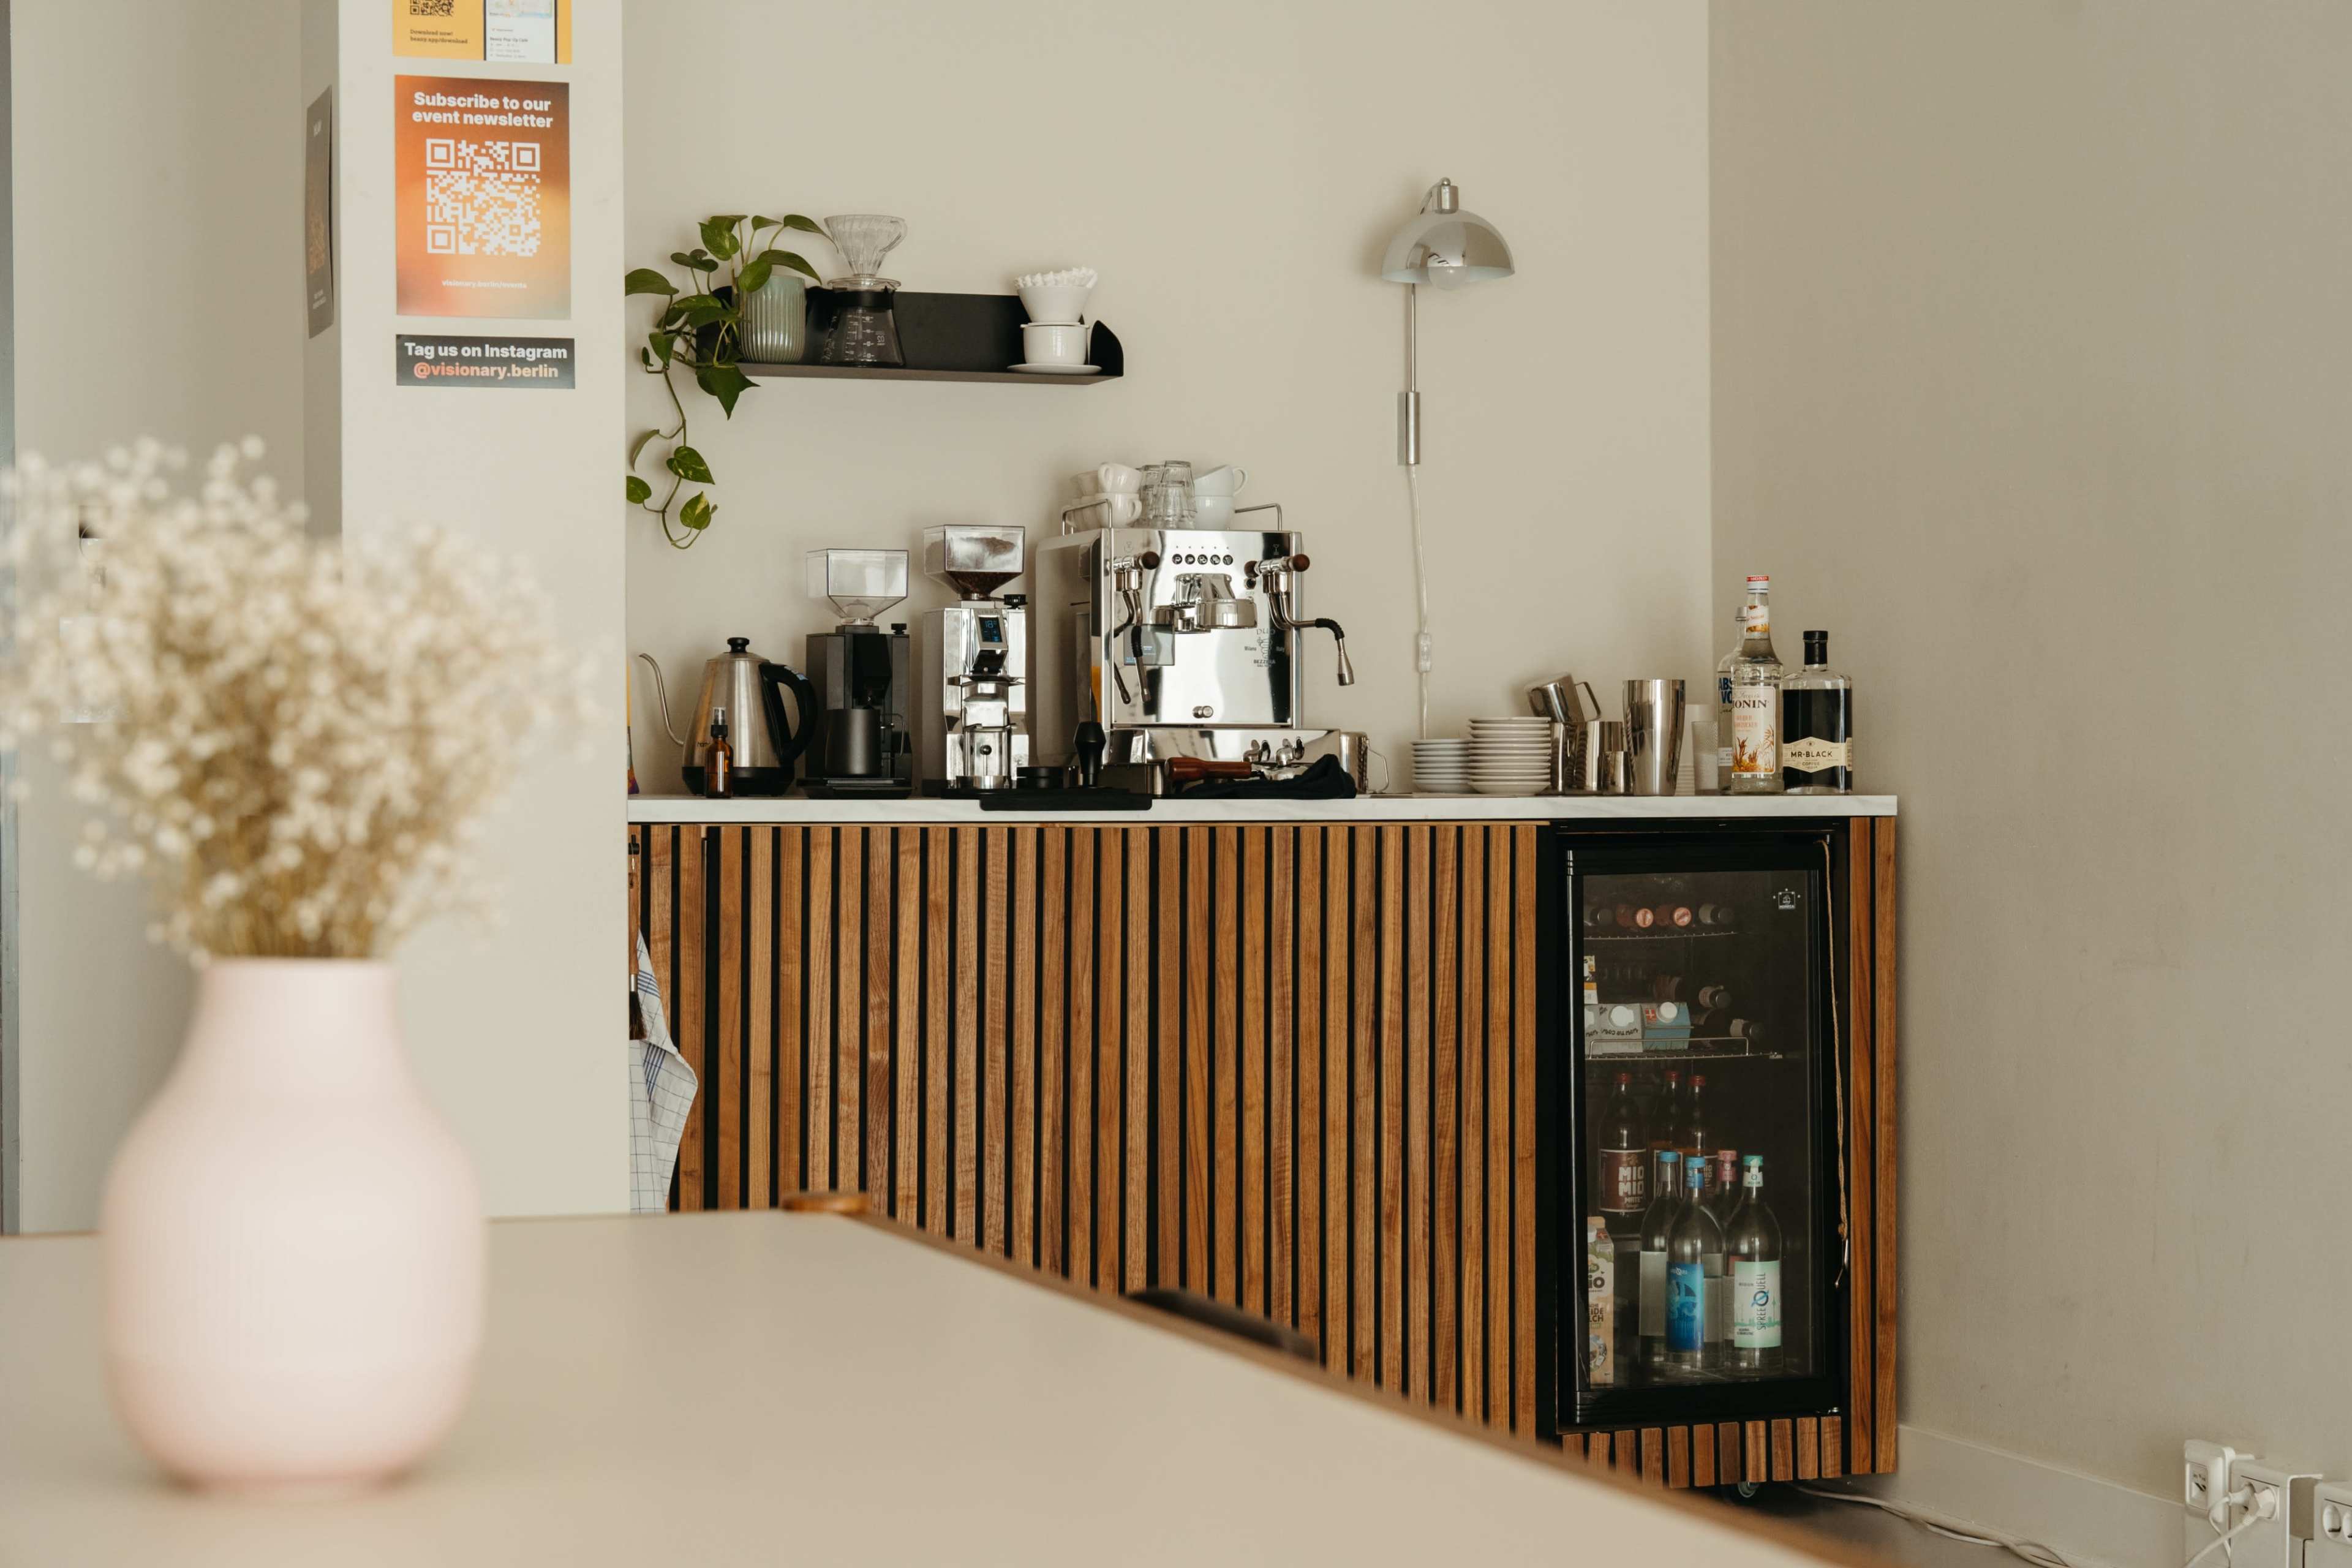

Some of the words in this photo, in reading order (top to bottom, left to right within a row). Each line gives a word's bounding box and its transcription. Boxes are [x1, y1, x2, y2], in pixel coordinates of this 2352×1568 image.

[414, 92, 500, 109] Subscribe
[502, 96, 520, 110] to
[522, 99, 551, 111] our
[412, 110, 460, 124] event
[463, 113, 554, 128] newsletter
[442, 279, 527, 288] visionary.berlin/events
[404, 342, 435, 360] Tag
[438, 345, 459, 357] us
[461, 347, 482, 358] on
[484, 344, 568, 361] Instagram
[413, 362, 559, 380] @visionary.berlin
[1618, 1166, 1645, 1181] MIO
[1618, 1181, 1645, 1196] MIO
